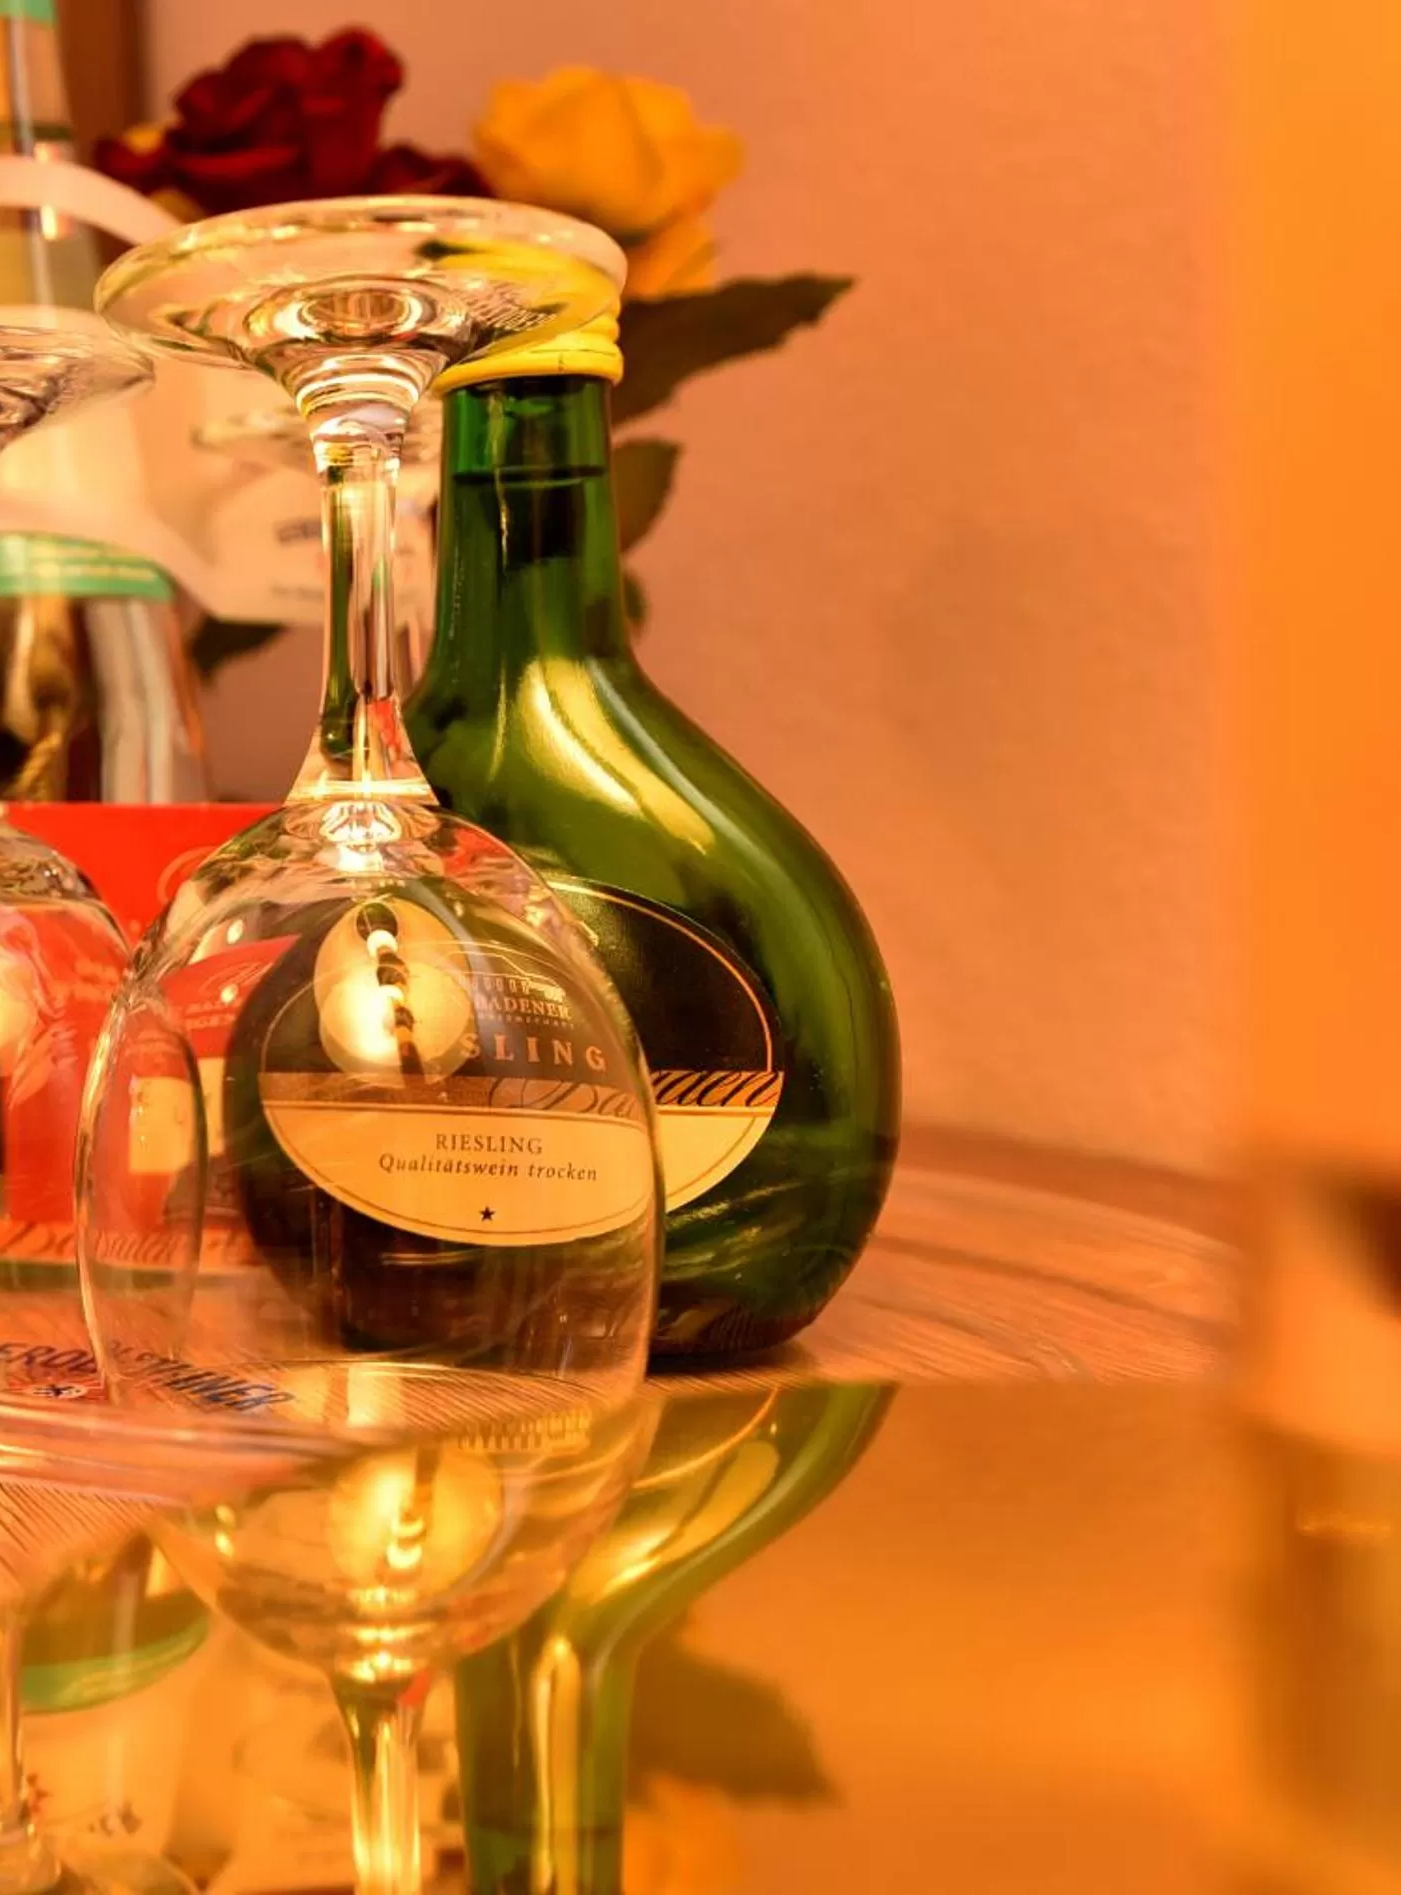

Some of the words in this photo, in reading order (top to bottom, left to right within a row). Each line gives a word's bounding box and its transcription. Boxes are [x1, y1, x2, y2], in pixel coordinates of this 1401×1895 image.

[459, 1032, 608, 1073] SLING
[435, 1133, 544, 1155] RIESLING
[527, 1161, 597, 1182] trocken
